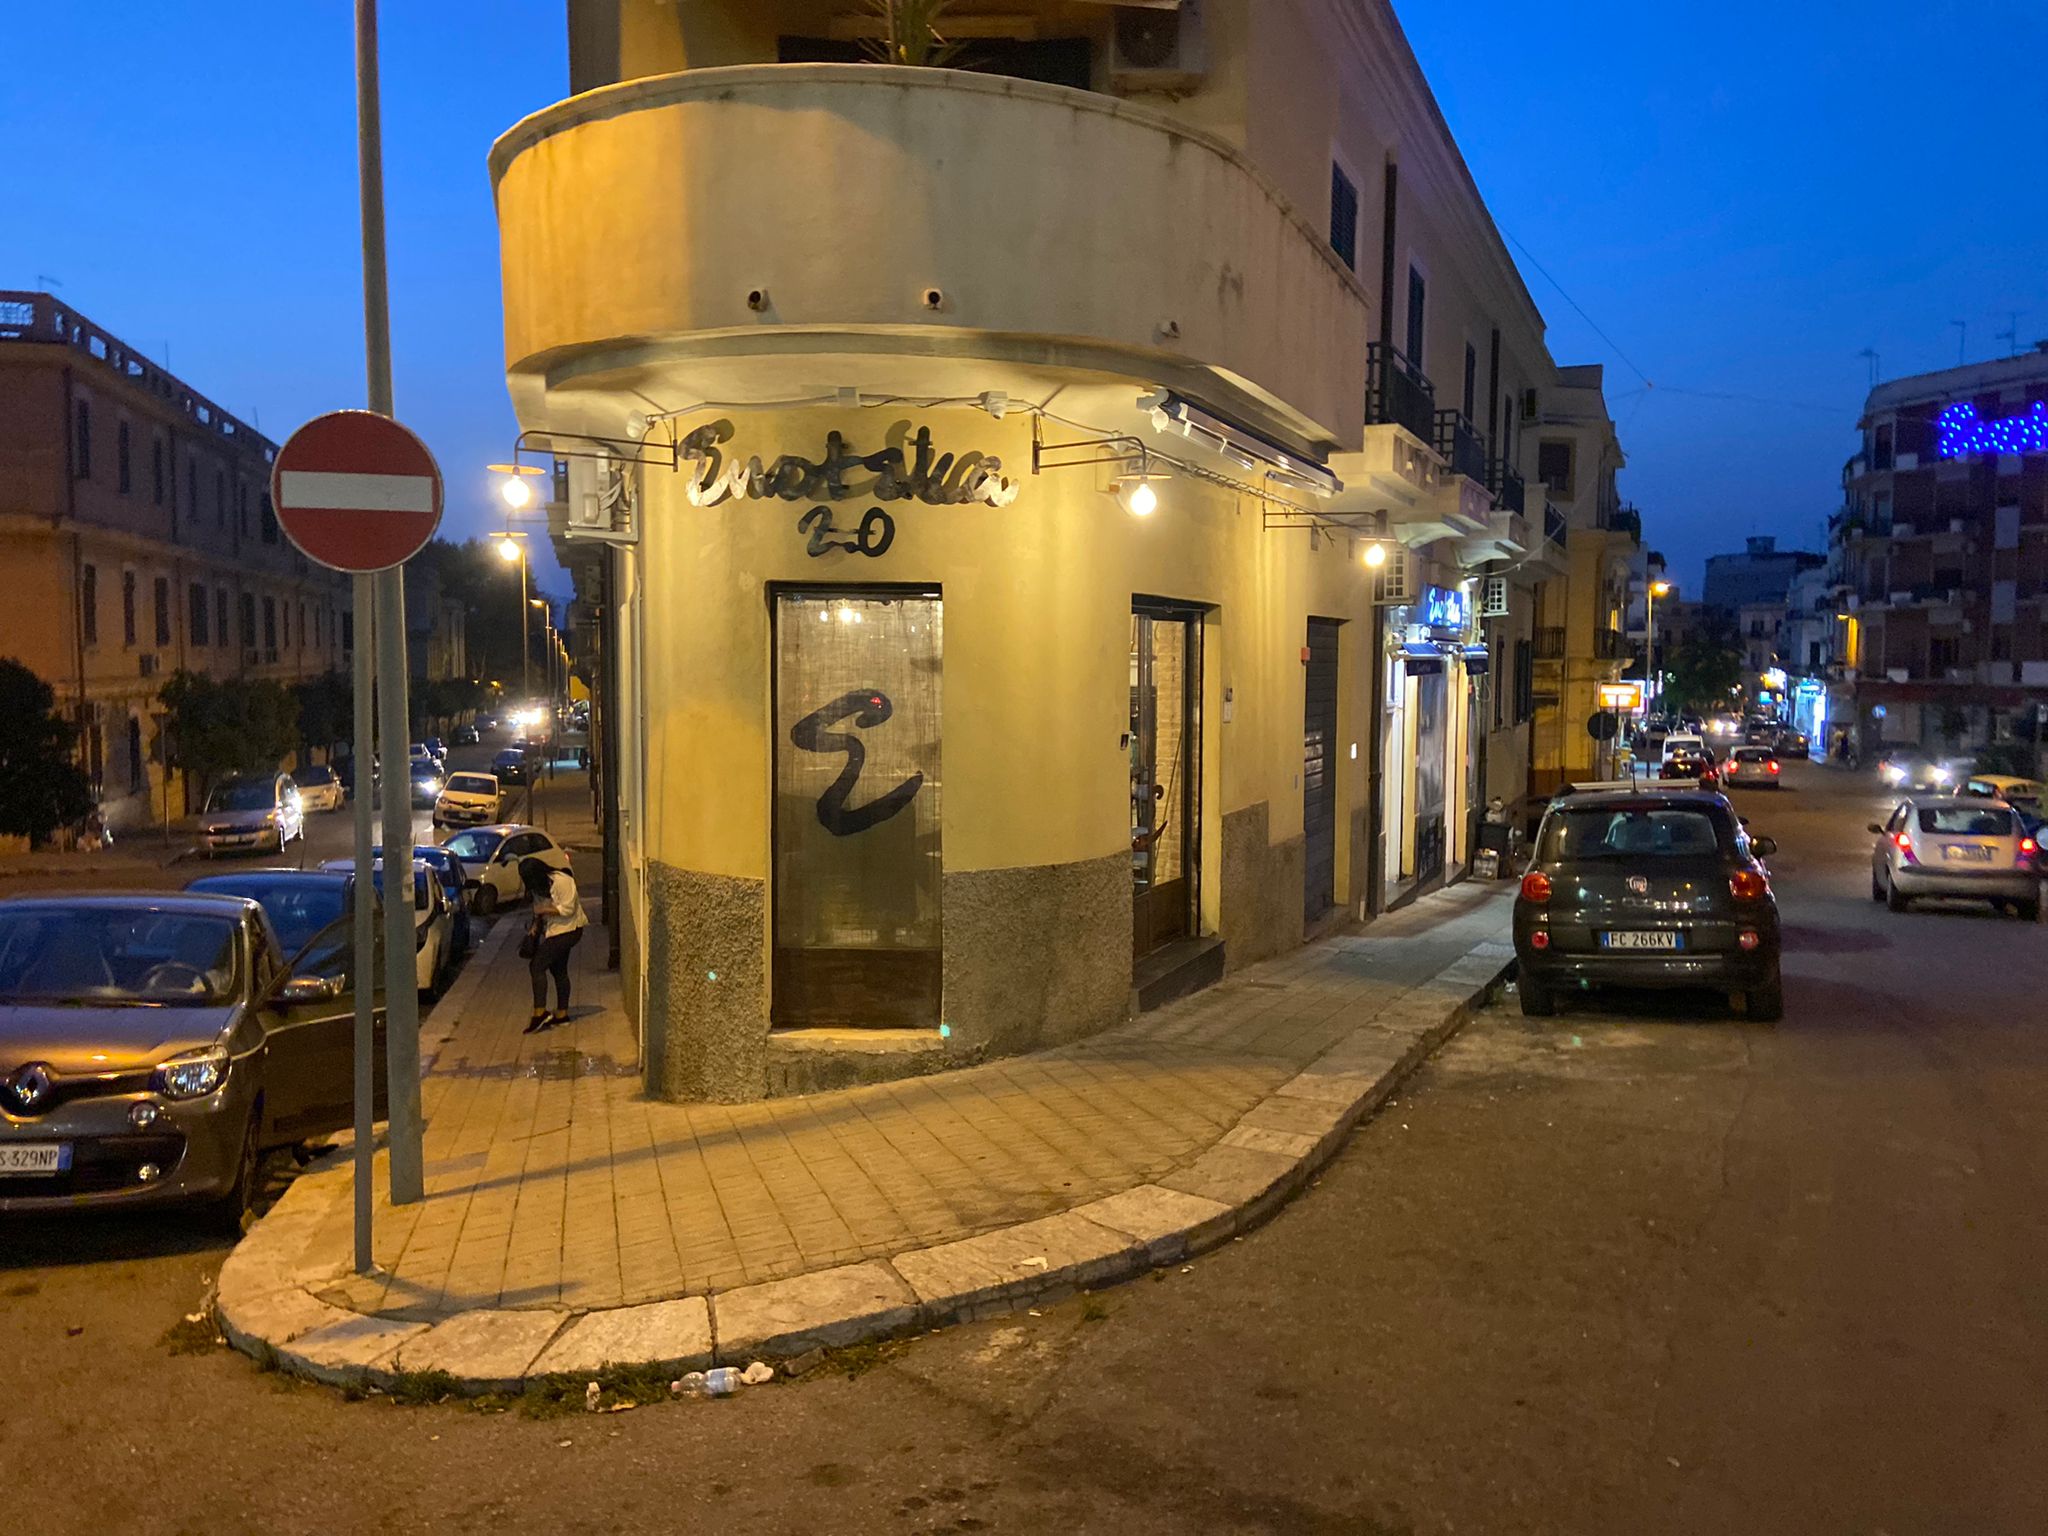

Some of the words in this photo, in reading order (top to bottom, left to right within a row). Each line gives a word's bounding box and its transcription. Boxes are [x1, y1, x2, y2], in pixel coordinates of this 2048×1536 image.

[1611, 933, 1627, 946] FC
[1632, 933, 1673, 946] 266KV
[11, 1150, 57, 1166] 329NP
